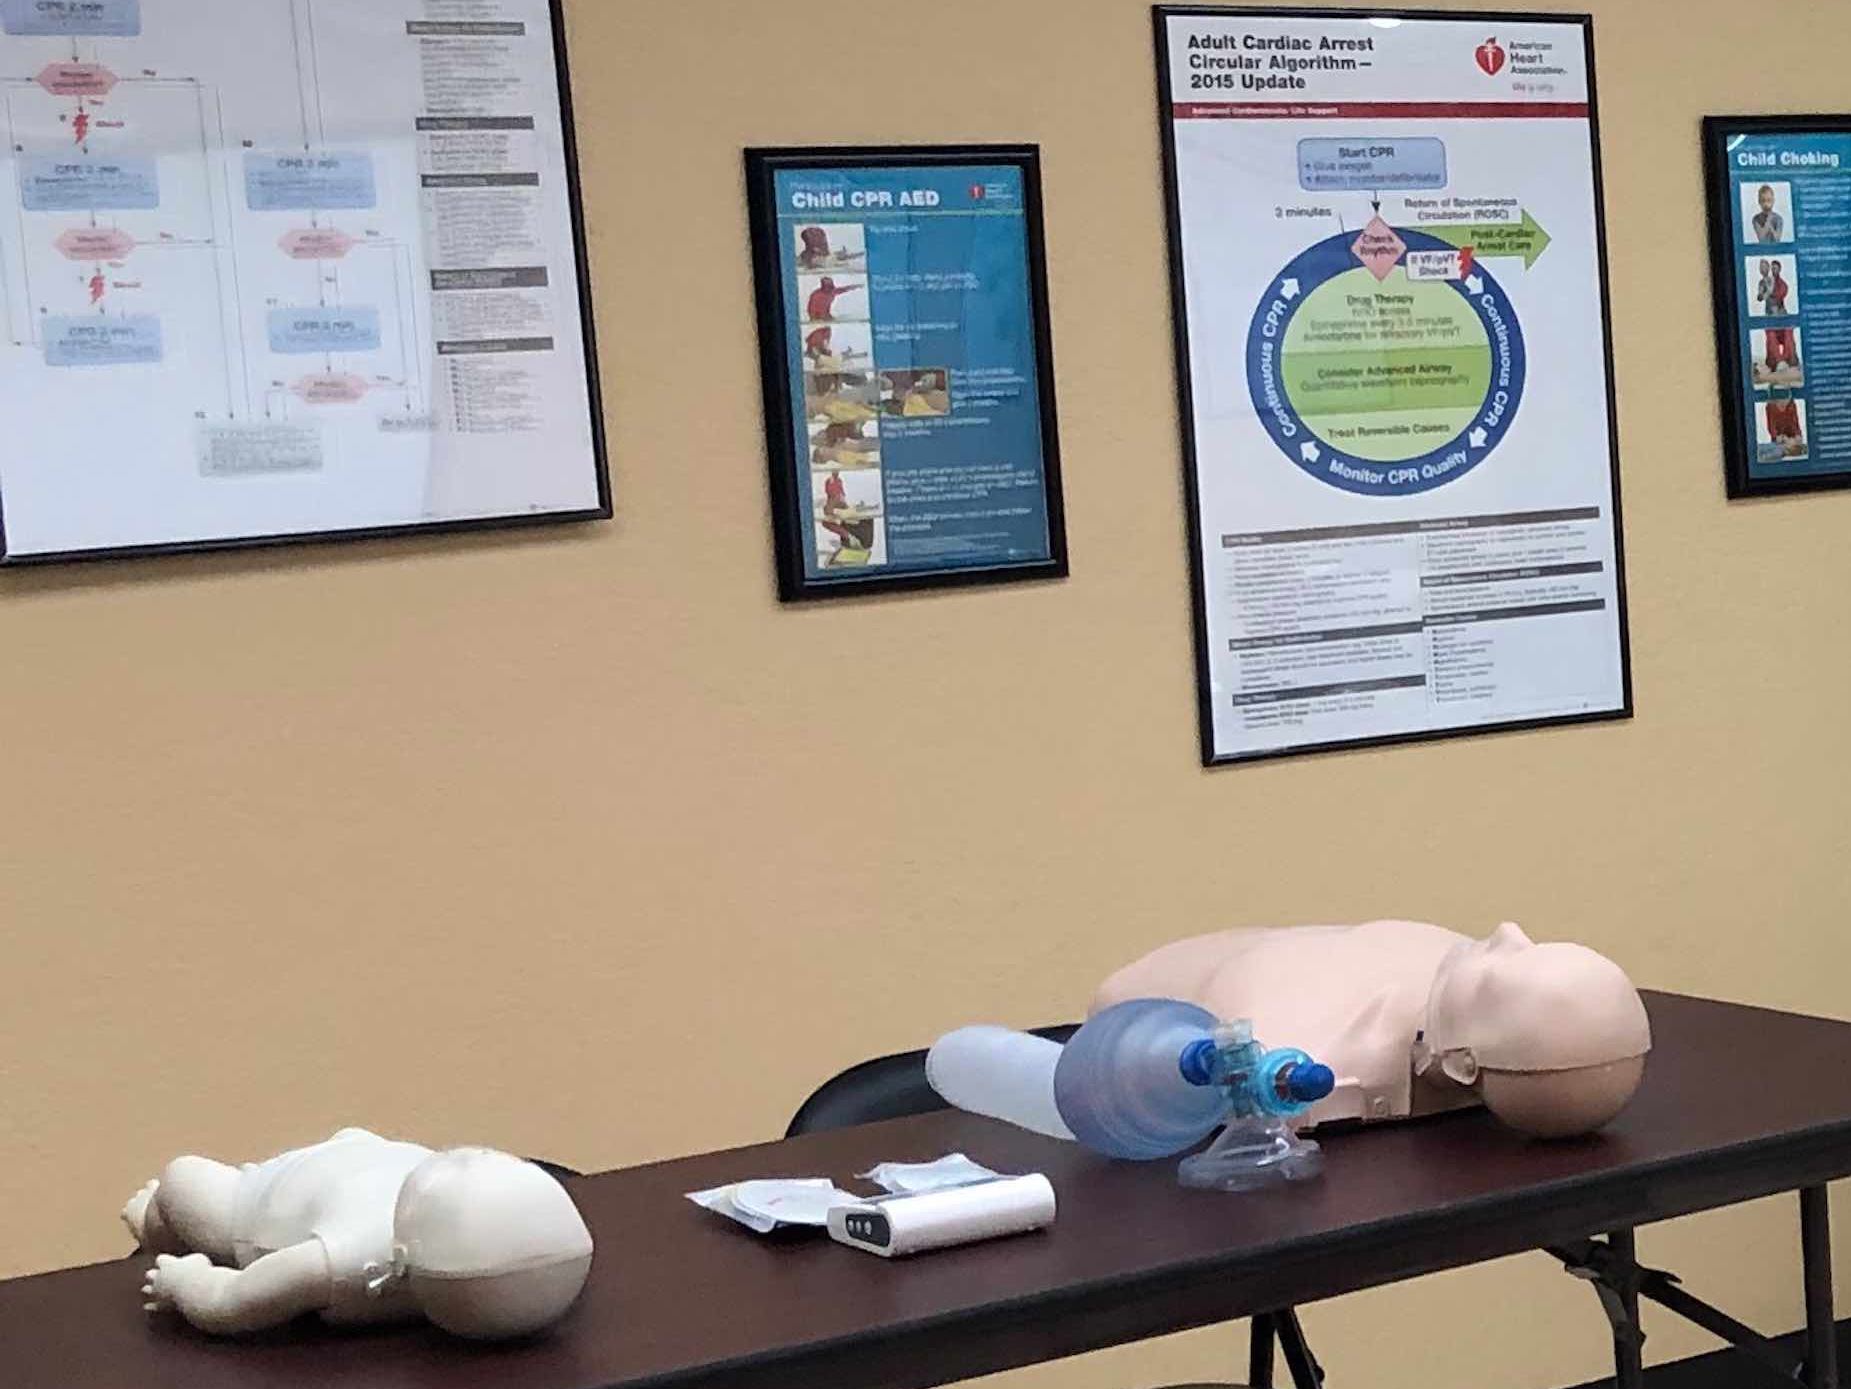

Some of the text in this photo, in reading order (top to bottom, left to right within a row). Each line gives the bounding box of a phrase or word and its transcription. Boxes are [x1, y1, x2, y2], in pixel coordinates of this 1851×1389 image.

[1188, 34, 1374, 51] Adult Cardiac Arrest
[1509, 41, 1553, 50] American
[1189, 54, 1262, 70] Circular
[1510, 53, 1543, 64] Heart
[1190, 74, 1306, 91] 2015 Update
[1338, 146, 1395, 159] Start CPR
[1737, 150, 1840, 168] Child Choking
[791, 189, 940, 209] Child CPR AED
[1404, 198, 1438, 208] Return
[1275, 207, 1332, 218] 2 minutes
[1473, 209, 1509, 220] (ROSC)
[1362, 233, 1395, 244] Check
[1359, 246, 1399, 258] Rhythm
[1418, 267, 1449, 276] Shock
[1346, 293, 1414, 307] Drug Therapy
[1480, 294, 1511, 427] Continuous CPR
[1261, 299, 1297, 438] Continuous CPR
[1317, 364, 1453, 379] Consider Advanced Airway
[1328, 423, 1450, 439] Treat Reversible Causes
[1328, 450, 1467, 485] Monitor CPR Quality
